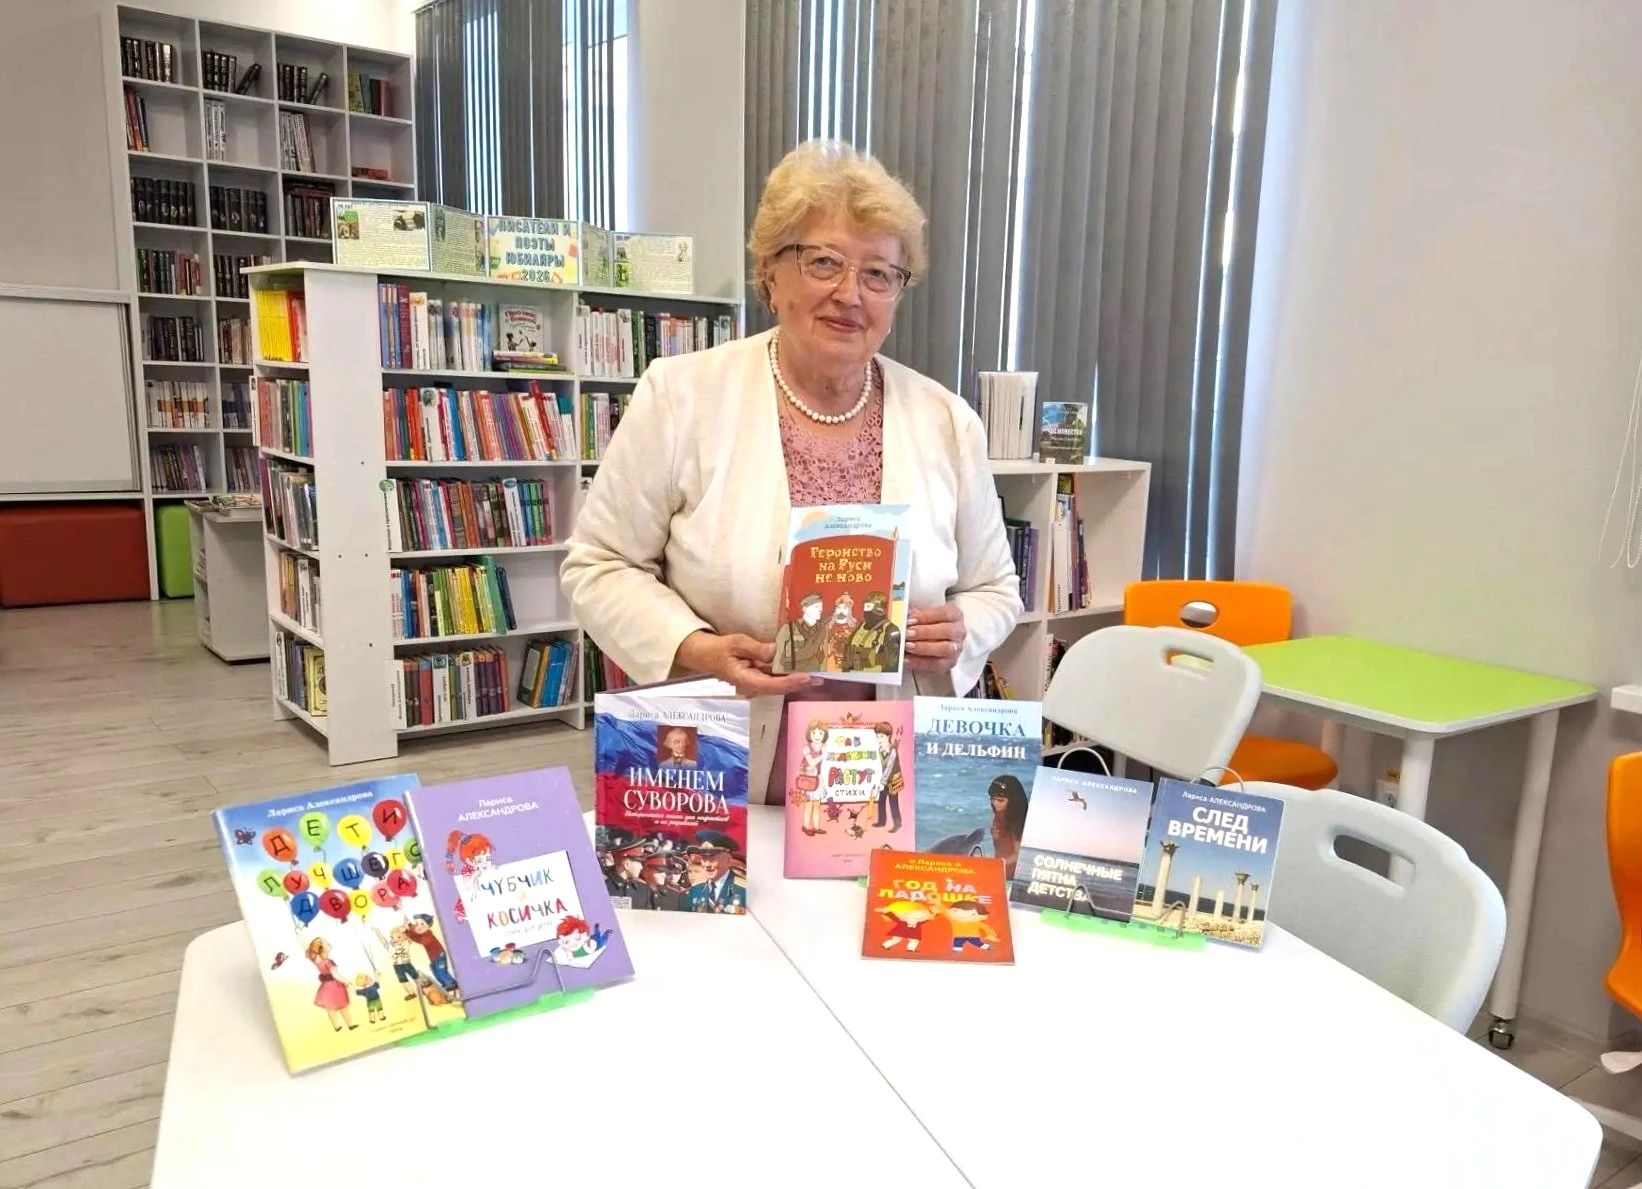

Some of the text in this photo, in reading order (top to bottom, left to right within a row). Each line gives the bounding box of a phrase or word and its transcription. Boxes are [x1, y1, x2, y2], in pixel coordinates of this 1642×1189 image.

[499, 219, 559, 235] ПИСАТЕЛИ
[515, 236, 555, 251] ПОЭТЫ
[506, 251, 565, 267] ЮБИЛЯРЫ
[521, 268, 550, 282] 2026
[819, 558, 873, 573] на Руси
[815, 572, 872, 583] не ново
[927, 719, 1026, 737] ДЕВОЧКА
[927, 742, 1027, 760] И ДЕЛЬФИН
[629, 766, 725, 792] ИМЕНЕМ
[828, 766, 876, 787] РАСТУТ
[267, 791, 374, 818] Лариса Александрова
[458, 801, 539, 822] АЛЕКСАНДРОВА
[479, 796, 513, 807] Лариса
[623, 789, 730, 814] СУВОРОВА
[1182, 791, 1266, 813] Лариса АЛЕКСАНДРОВА
[1192, 806, 1249, 835] СЛЕД
[270, 808, 398, 856] ДЕТИ
[1167, 819, 1268, 854] ВРЕМЕНИ
[894, 863, 976, 874] АЛЕКСАНДРОВА
[1031, 867, 1077, 887] ПЯТНА
[1034, 854, 1124, 881] СОЛНЕЧНЫЕ
[480, 868, 555, 896] ЧУБЧИК
[892, 880, 937, 893] ГОД
[300, 876, 410, 914] ДВОРА
[877, 888, 993, 905] ЛАДОШКЕ
[487, 897, 568, 930] КОСИЧКА
